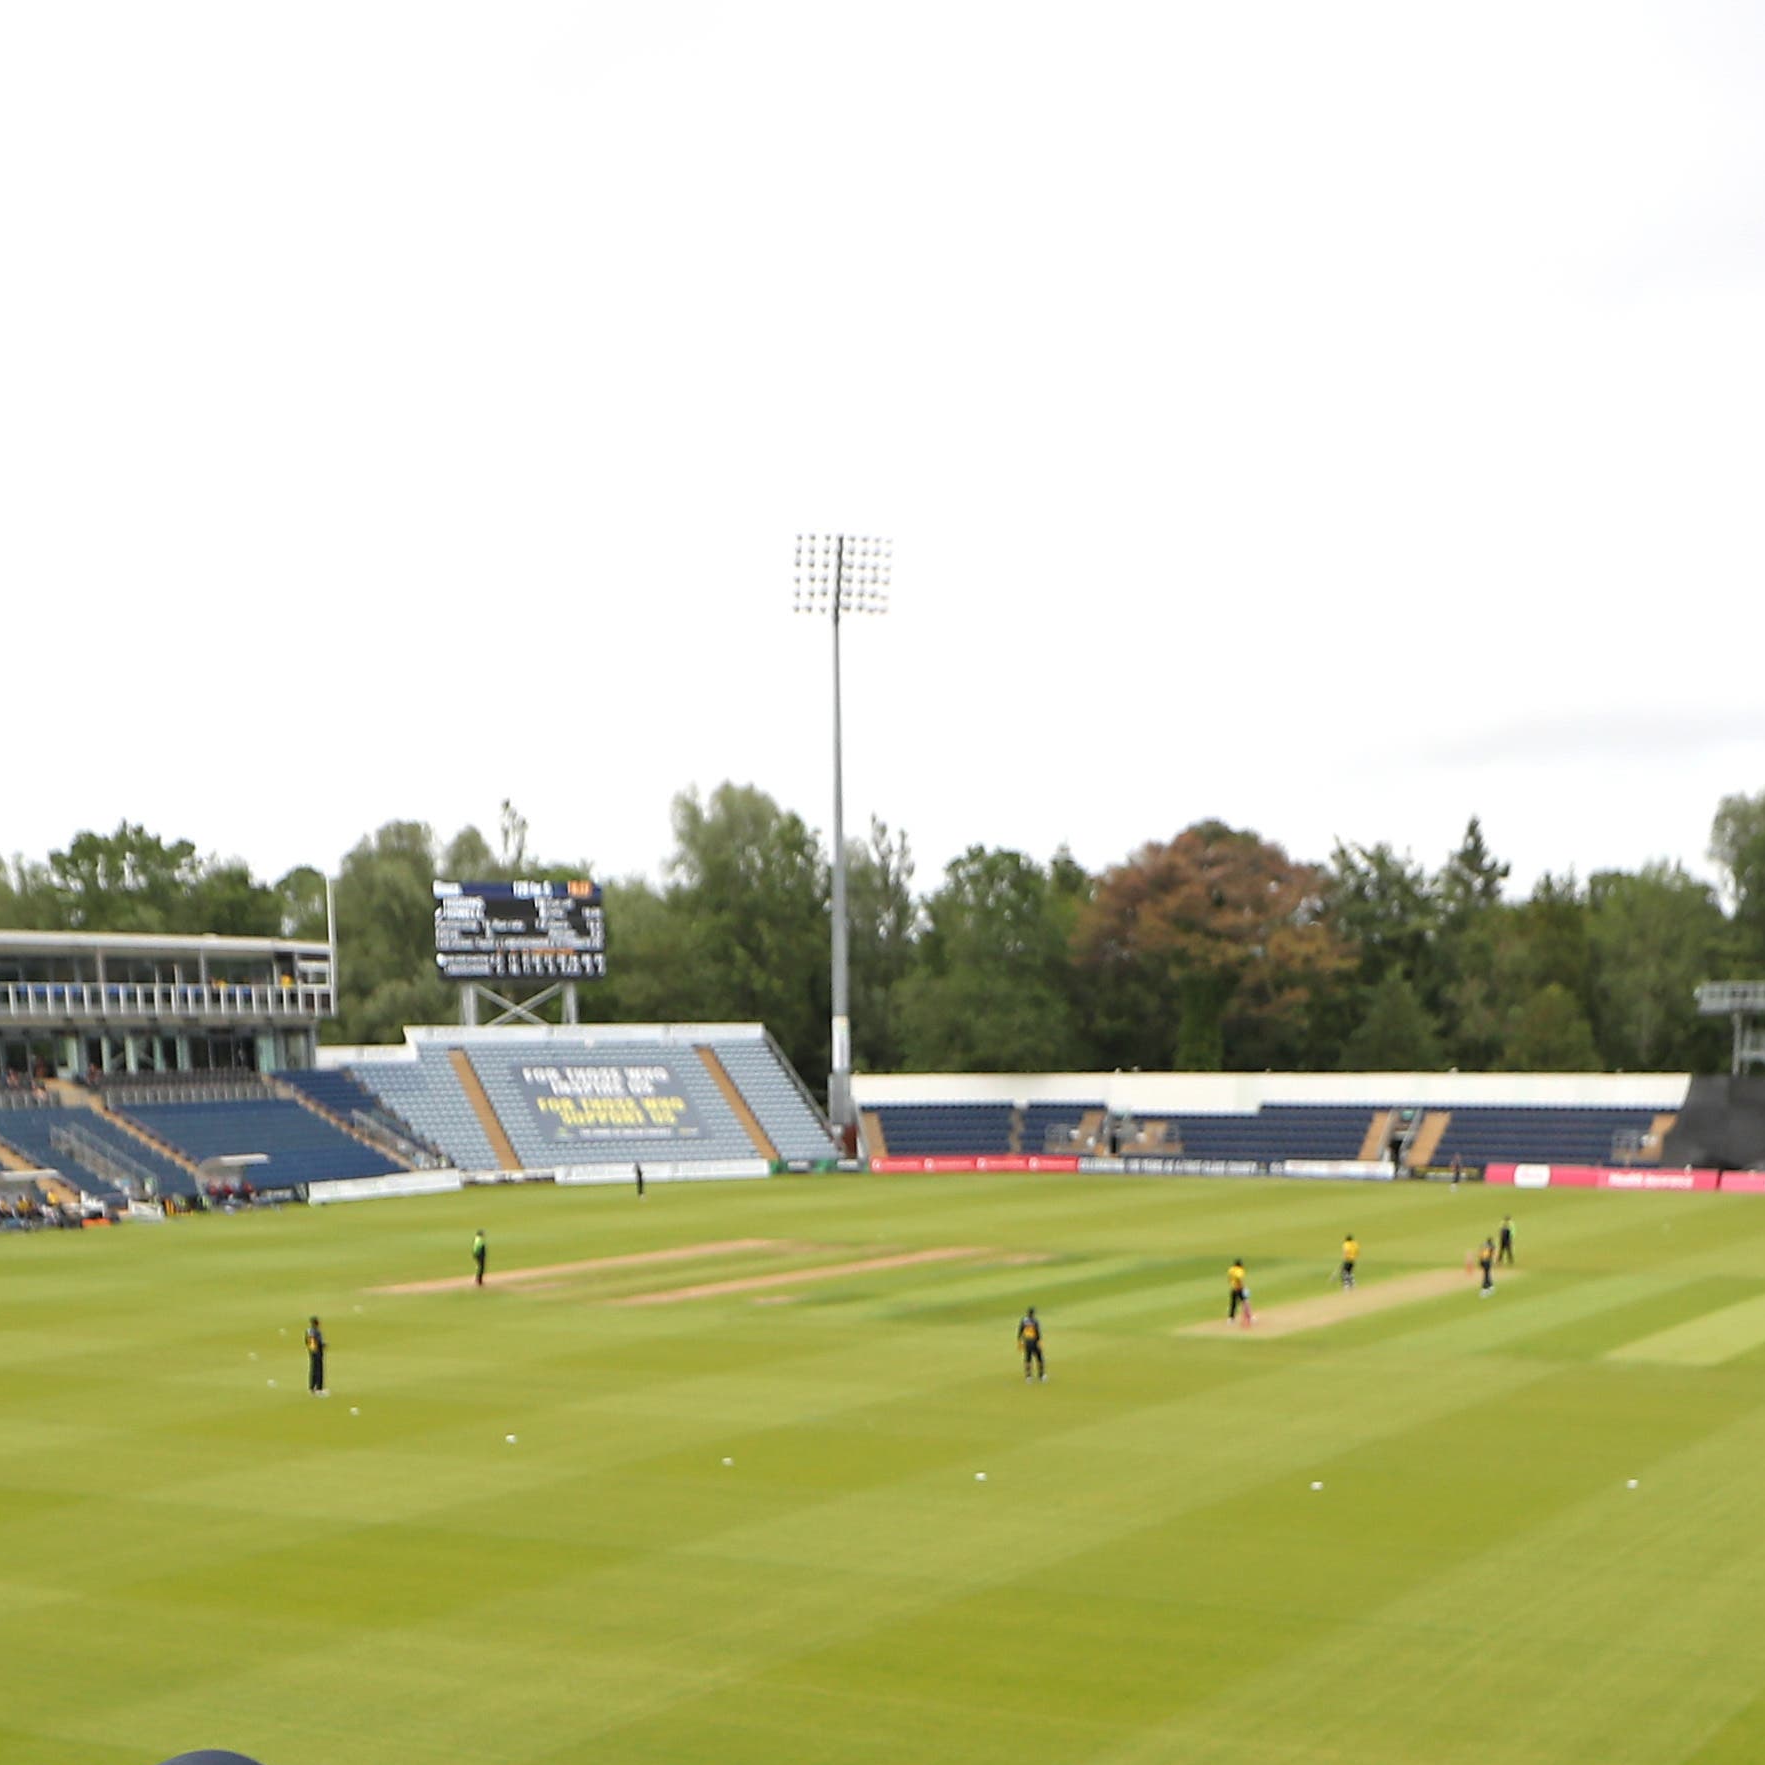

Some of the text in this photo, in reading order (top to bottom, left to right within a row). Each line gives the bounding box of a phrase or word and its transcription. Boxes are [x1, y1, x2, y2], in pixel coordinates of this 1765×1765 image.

[522, 1065, 560, 1084] FOR
[565, 1065, 621, 1084] THOSE
[537, 1096, 575, 1113] FOR
[580, 1096, 638, 1113] THOSE
